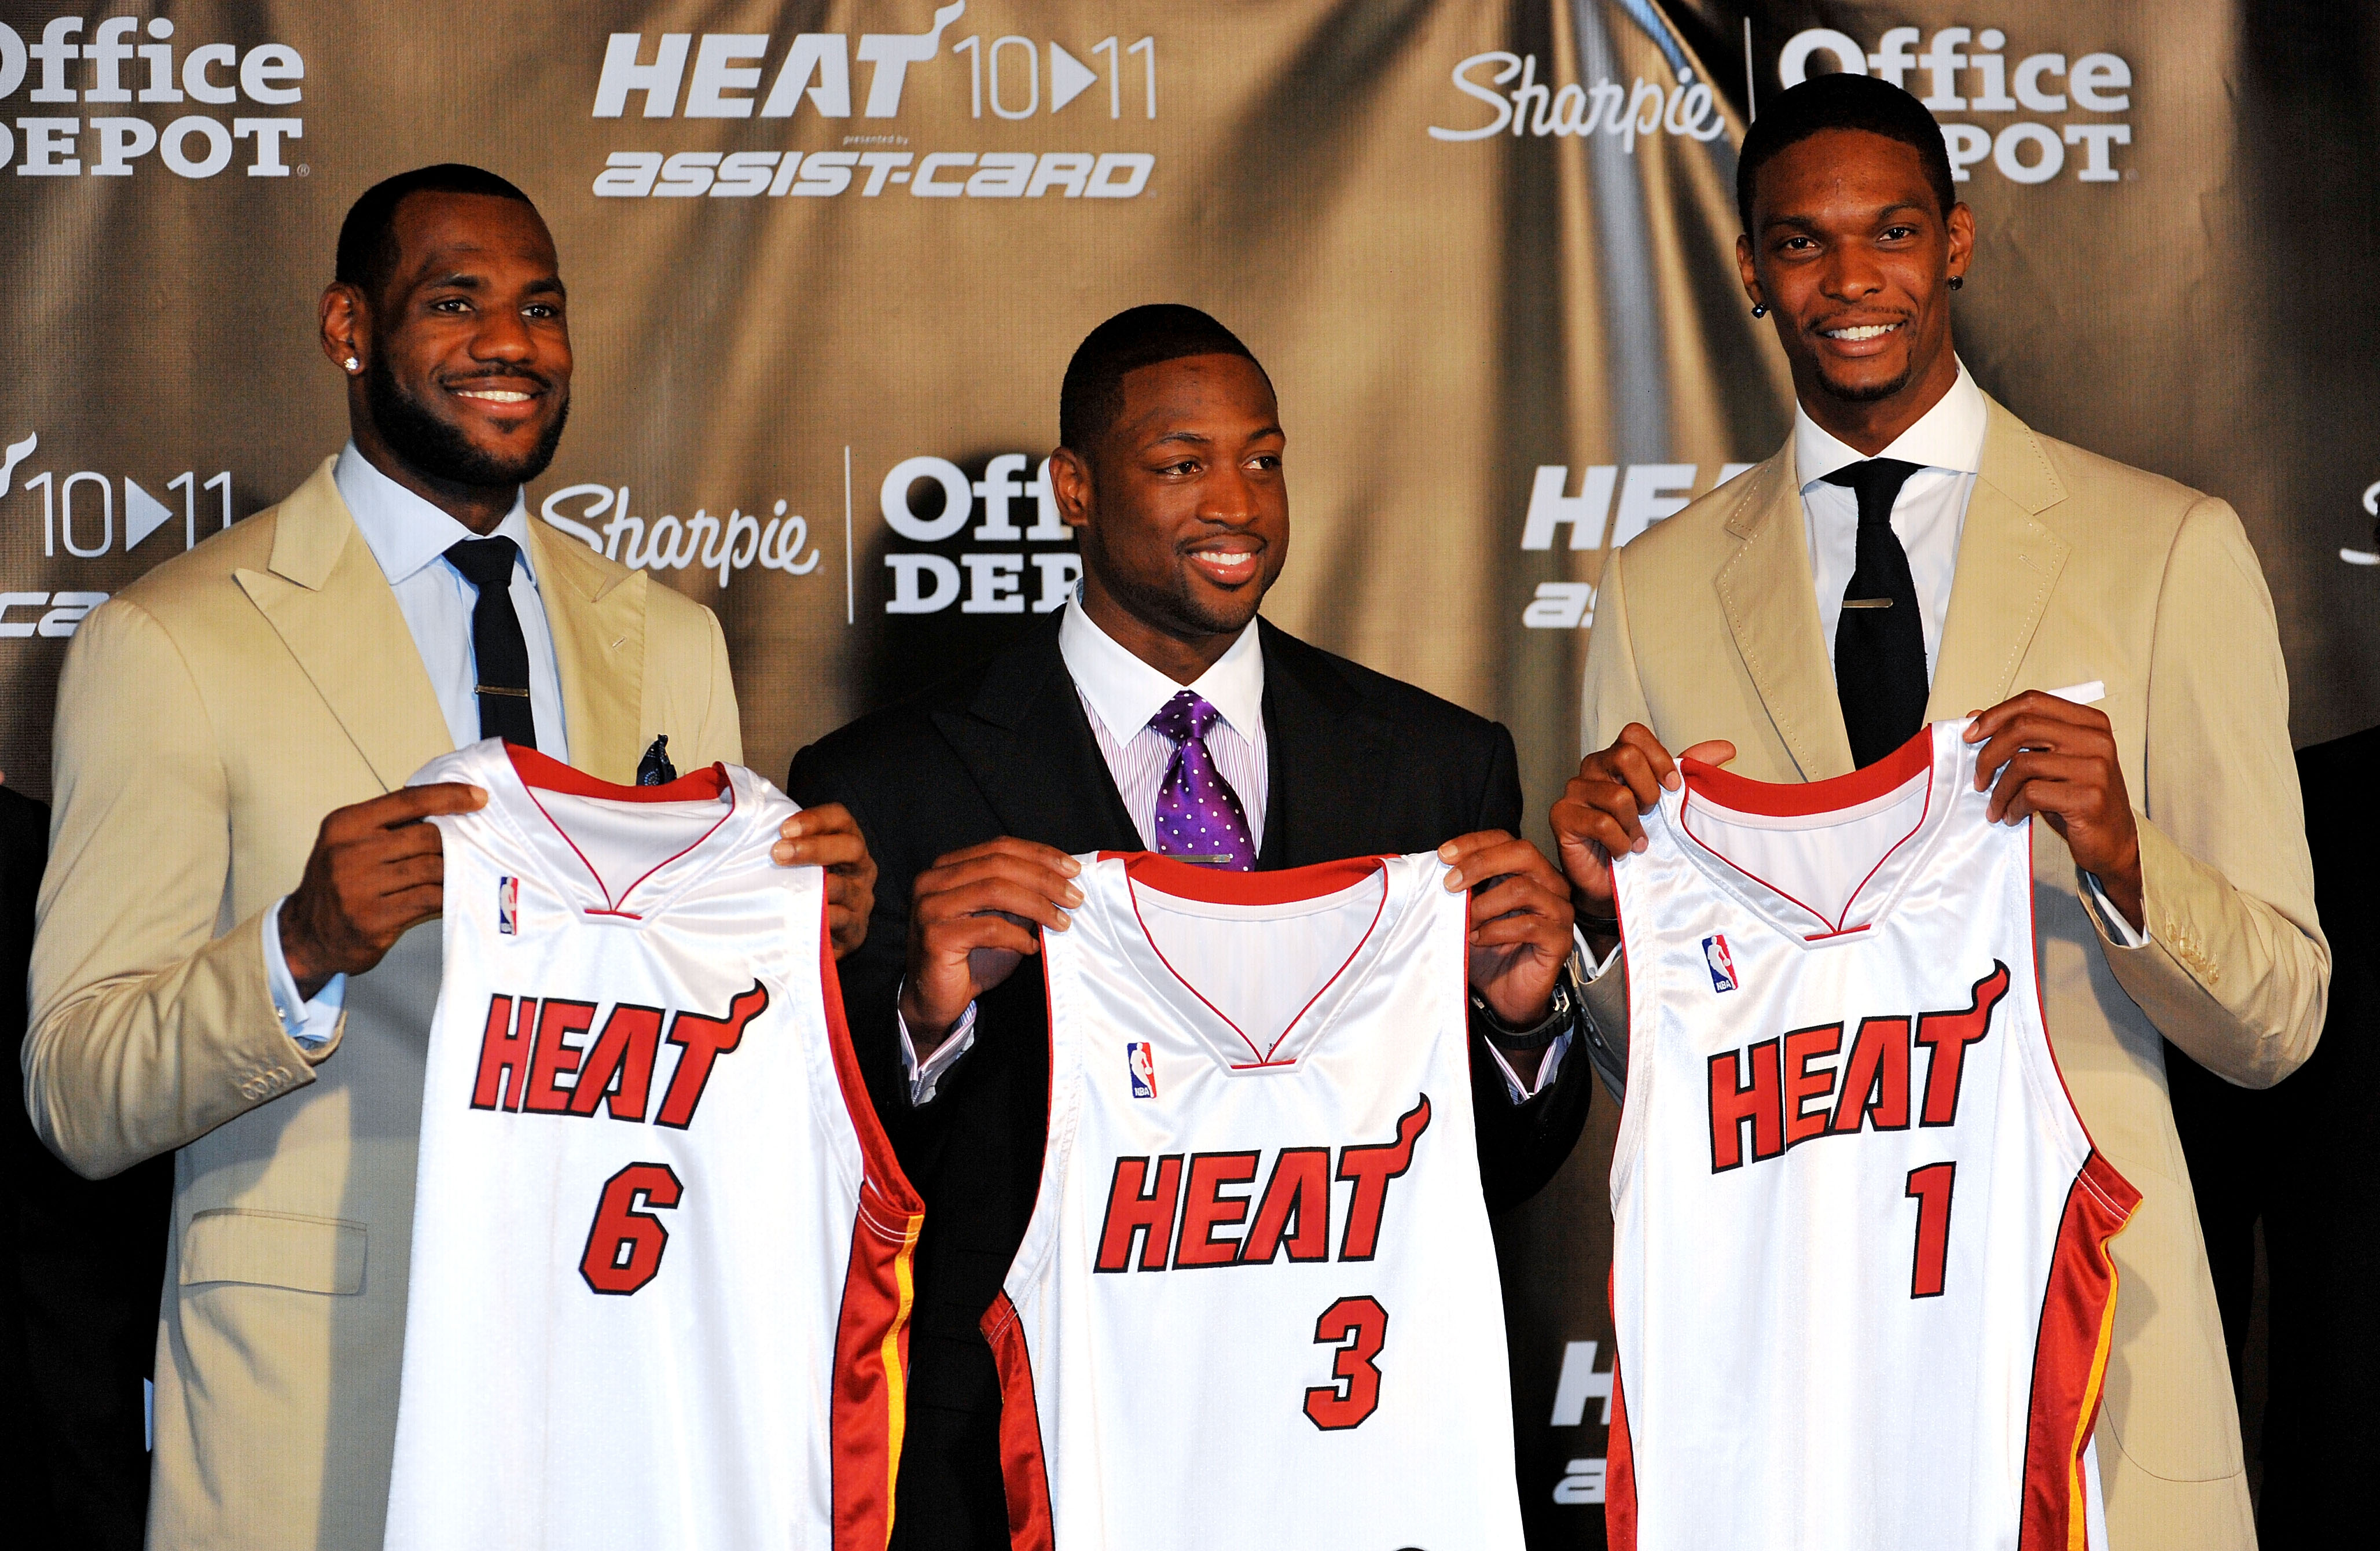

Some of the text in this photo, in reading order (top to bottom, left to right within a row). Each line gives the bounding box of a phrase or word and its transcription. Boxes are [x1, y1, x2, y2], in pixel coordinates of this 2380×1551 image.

[592, 0, 1155, 119] HEAT 10 11
[1428, 51, 1724, 154] Sharpie
[0, 115, 302, 179] EPOT
[1941, 122, 2131, 183] POT
[540, 483, 820, 589] Sharpie
[880, 449, 1074, 542] Off
[1521, 464, 1756, 550] HE
[884, 553, 1084, 614] DEP
[1716, 979, 1732, 991] NBA
[469, 977, 770, 1130] HEAT
[1134, 1087, 1150, 1097] NBA
[1707, 957, 2011, 1175] HEAT
[579, 1161, 684, 1296] 6
[1093, 1091, 1432, 1274] HEAT
[1904, 1160, 1957, 1300] 1
[1302, 1295, 1389, 1432] 3
